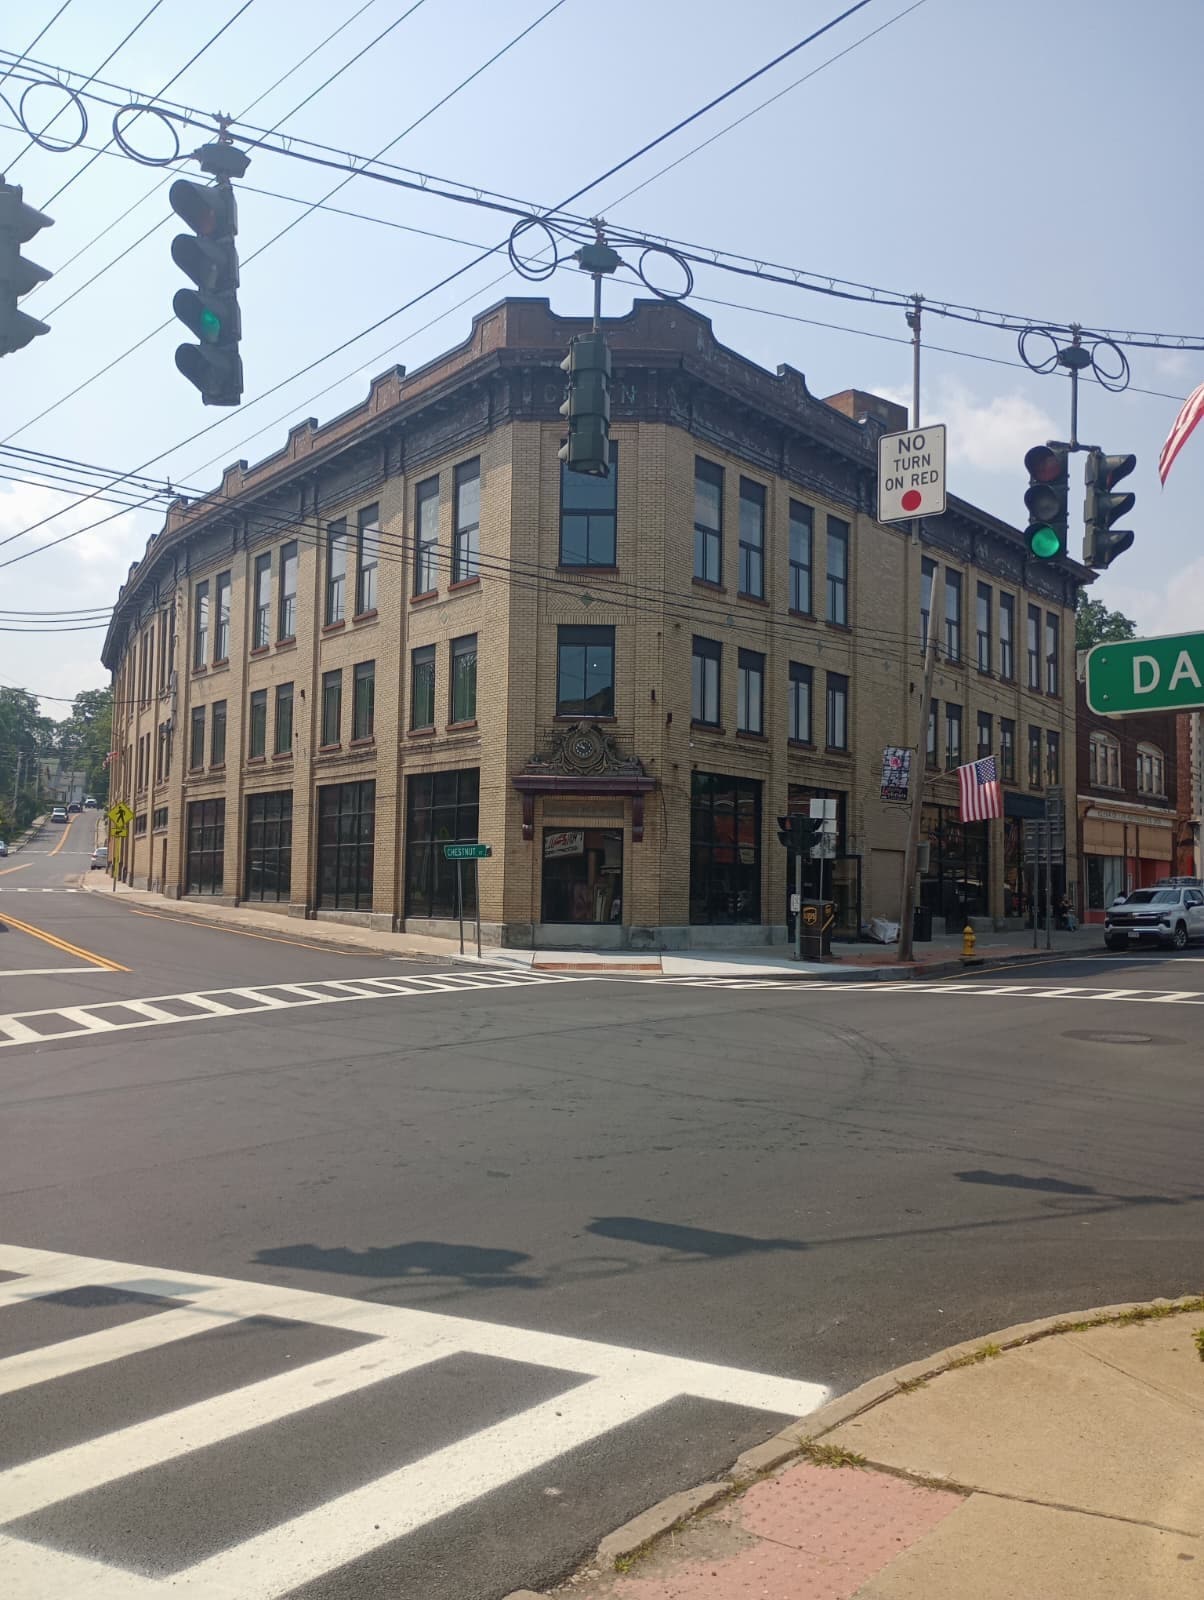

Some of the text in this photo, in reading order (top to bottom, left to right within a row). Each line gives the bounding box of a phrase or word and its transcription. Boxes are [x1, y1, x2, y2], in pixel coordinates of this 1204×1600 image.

[898, 434, 926, 454] NO
[893, 453, 931, 472] TURN
[885, 470, 939, 491] ON RED
[447, 847, 476, 857] CHESTNUT
